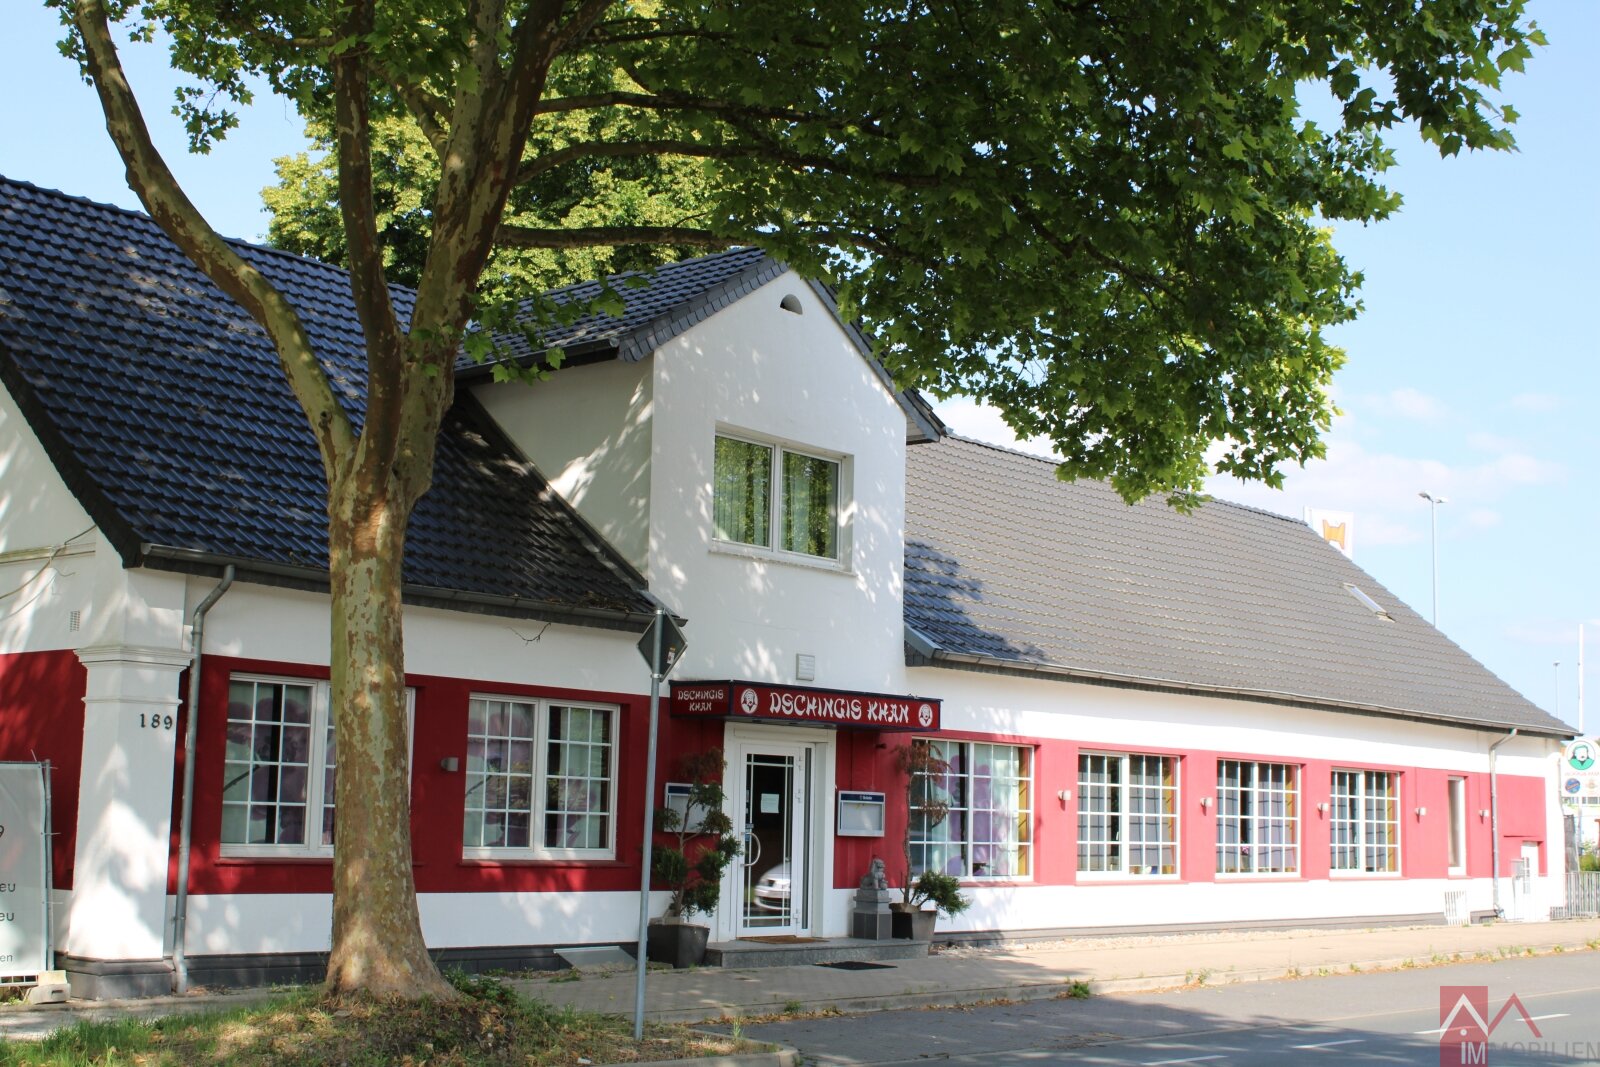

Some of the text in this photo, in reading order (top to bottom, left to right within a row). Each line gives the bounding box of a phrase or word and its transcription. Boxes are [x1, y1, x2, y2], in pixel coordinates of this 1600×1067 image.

[677, 689, 724, 701] DSCHINGIS
[689, 702, 712, 712] KHAN
[769, 692, 909, 724] DSCHINGIS KHAN
[139, 713, 173, 731] 189
